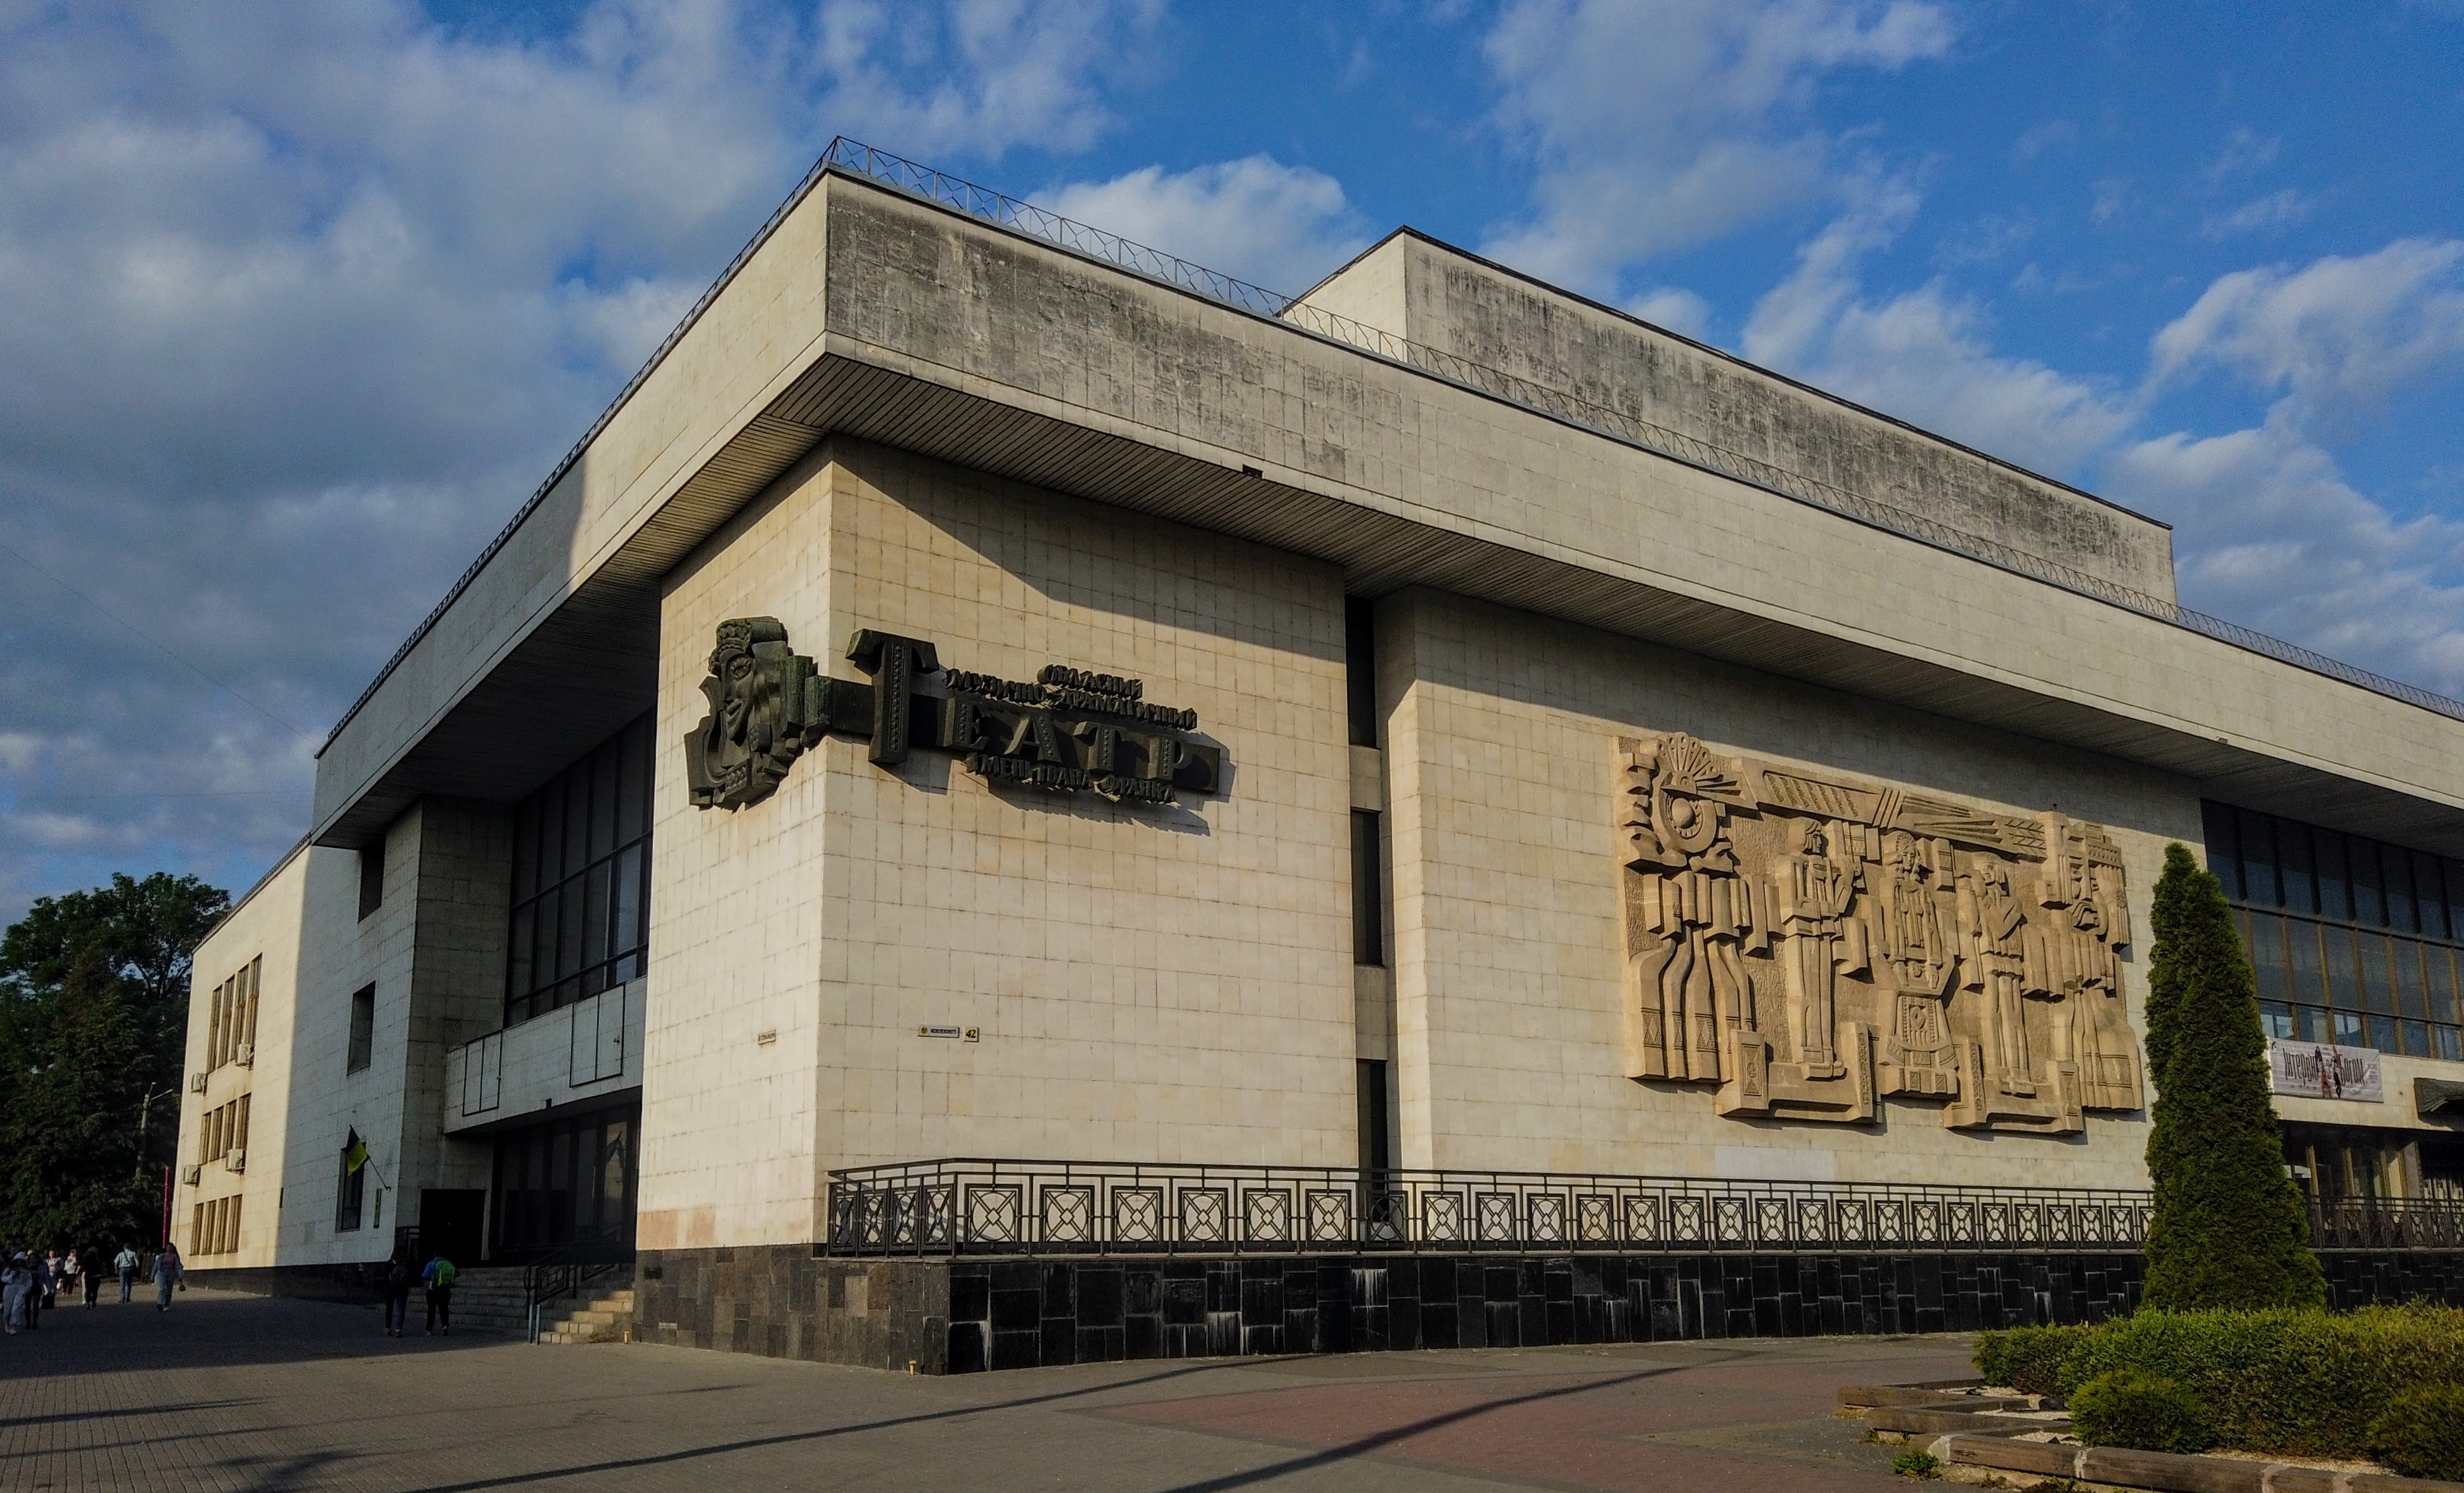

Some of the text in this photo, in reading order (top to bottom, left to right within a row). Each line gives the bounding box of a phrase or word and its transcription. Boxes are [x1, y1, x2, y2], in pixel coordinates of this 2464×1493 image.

[846, 628, 1194, 782] ТЕАТР
[1100, 773, 1177, 803] ФРАНКА
[965, 1029, 976, 1038] 42
